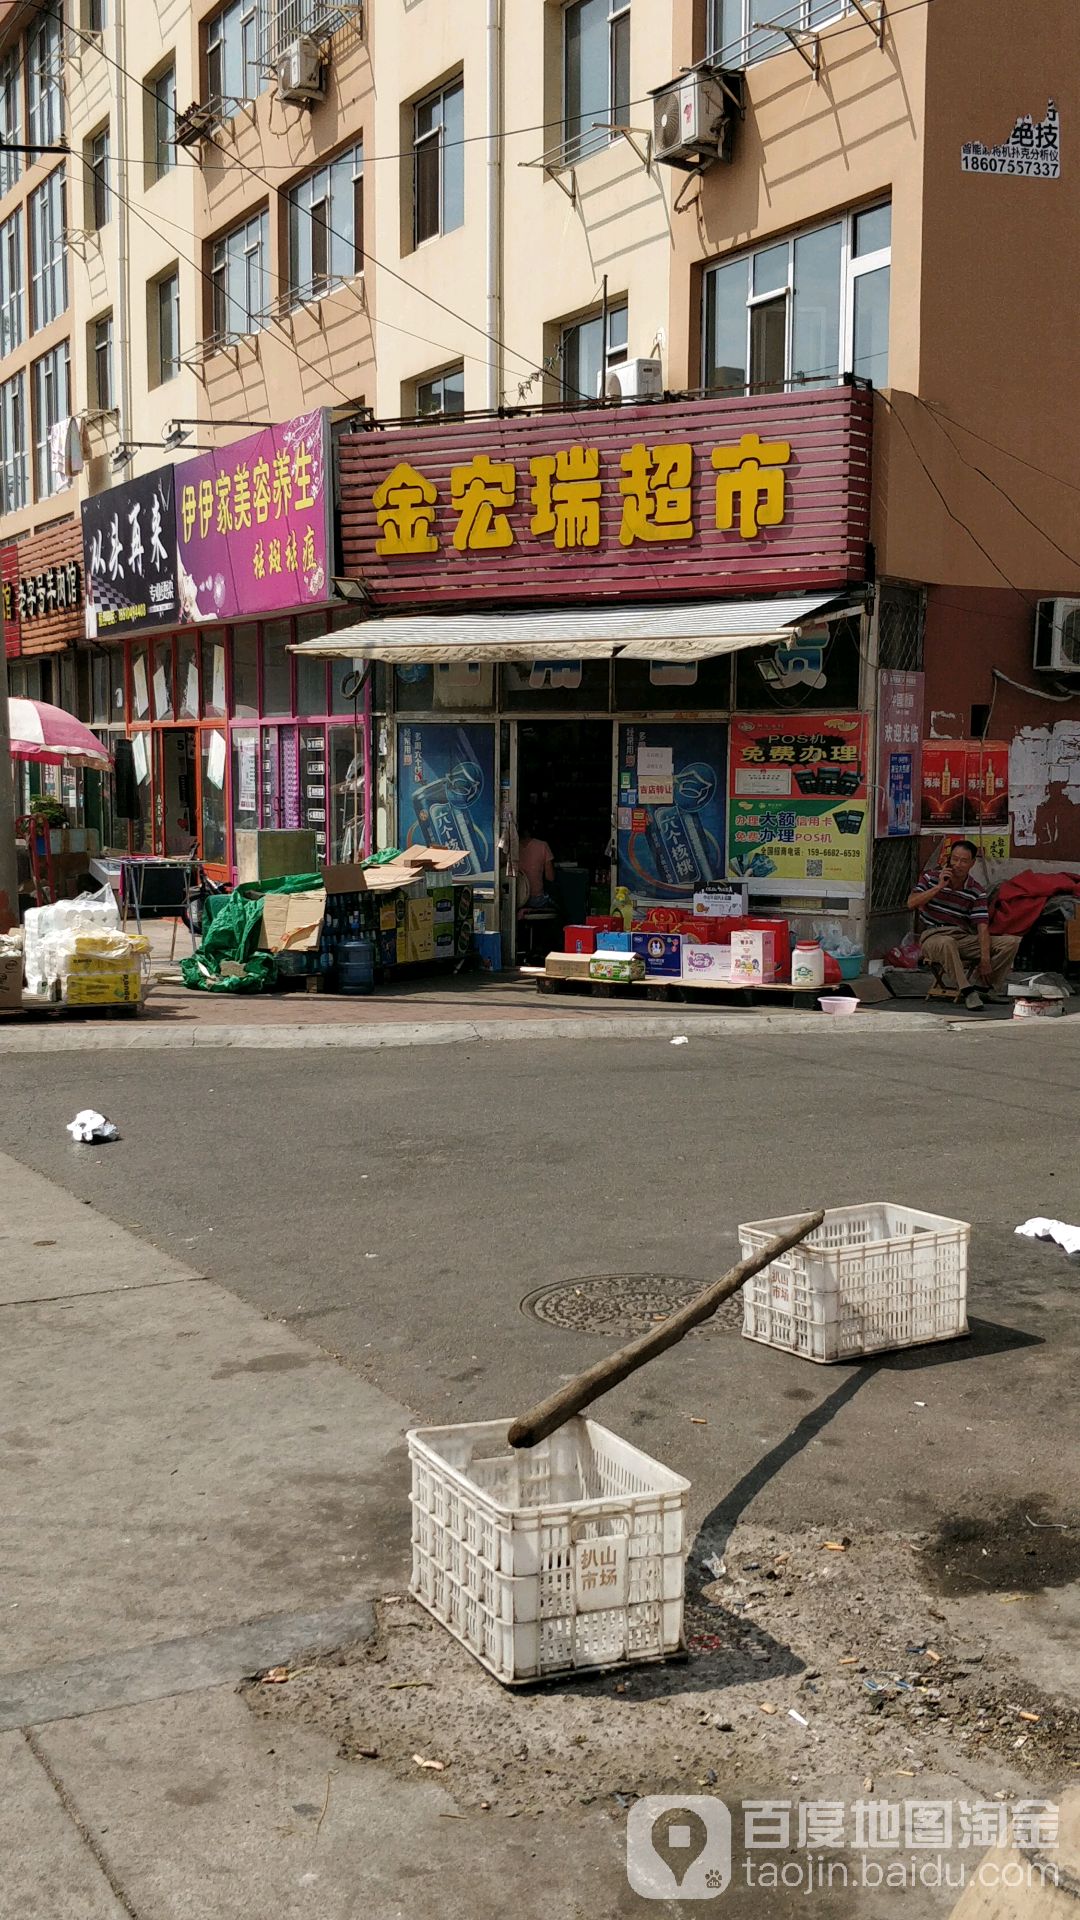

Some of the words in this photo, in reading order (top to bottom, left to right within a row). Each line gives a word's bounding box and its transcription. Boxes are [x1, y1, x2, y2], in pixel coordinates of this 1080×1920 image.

[1011, 115, 1059, 150] 绝技
[962, 155, 1059, 177] 18607557337
[181, 441, 315, 544] 伊伊家美容养生
[372, 433, 791, 556] 金宏瑞超市
[90, 493, 168, 581] 从头再来
[768, 734, 826, 744] POS机
[884, 723, 919, 743] 欢迎光临
[741, 745, 858, 762] 免费办理
[735, 811, 833, 827] 办理大额信用卡
[661, 816, 695, 876] 六个核桃
[735, 828, 833, 843] 免费办理POS机
[581, 1546, 617, 1570] 扒山
[581, 1569, 618, 1591] 市场
